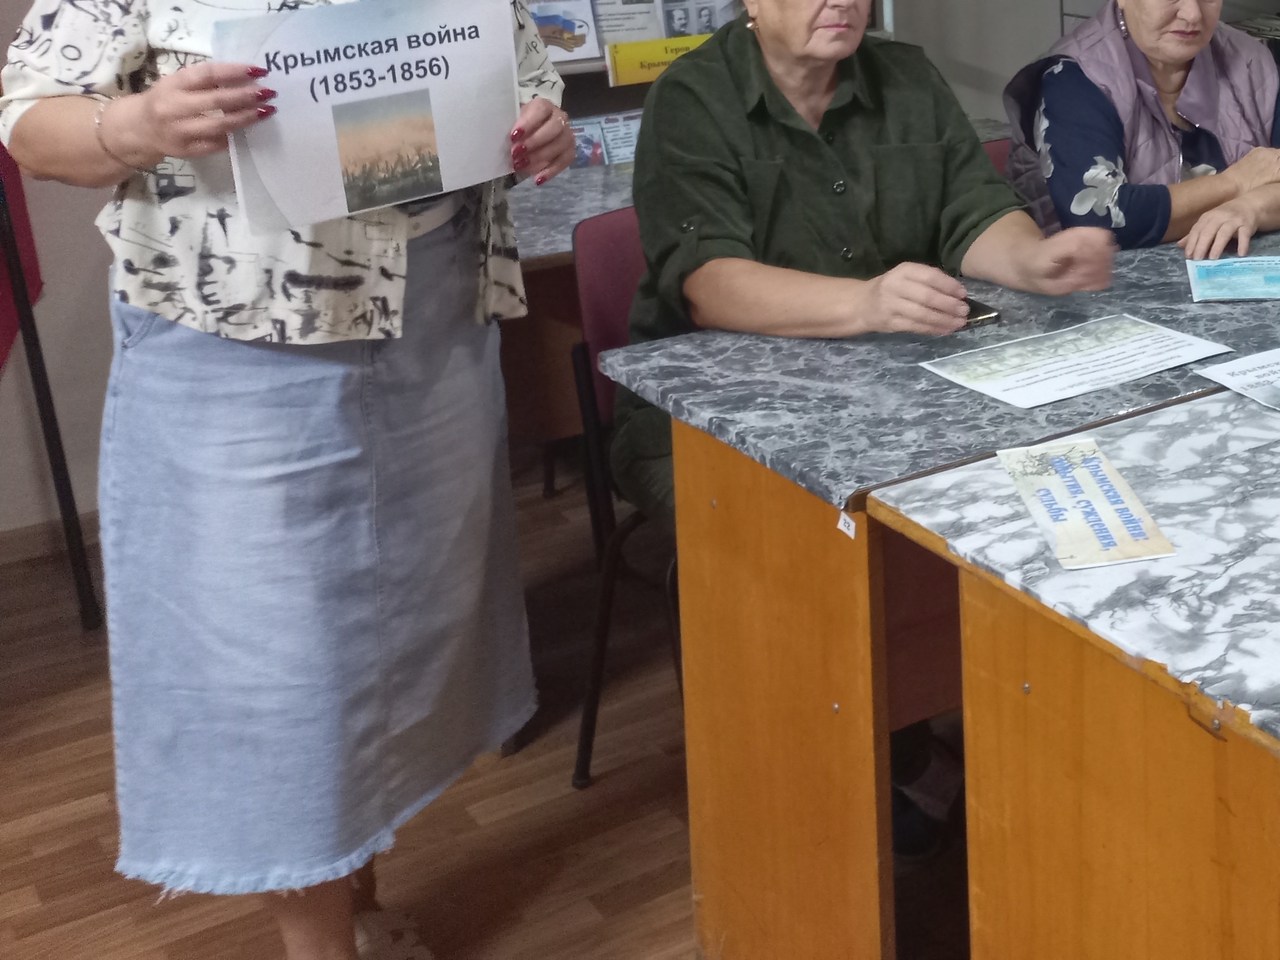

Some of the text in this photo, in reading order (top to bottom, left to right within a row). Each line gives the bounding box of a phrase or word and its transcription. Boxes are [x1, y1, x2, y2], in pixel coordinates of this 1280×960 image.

[265, 24, 480, 75] Крымская война
[309, 55, 450, 103] (1853-1856)
[1081, 456, 1125, 506] Крымская
